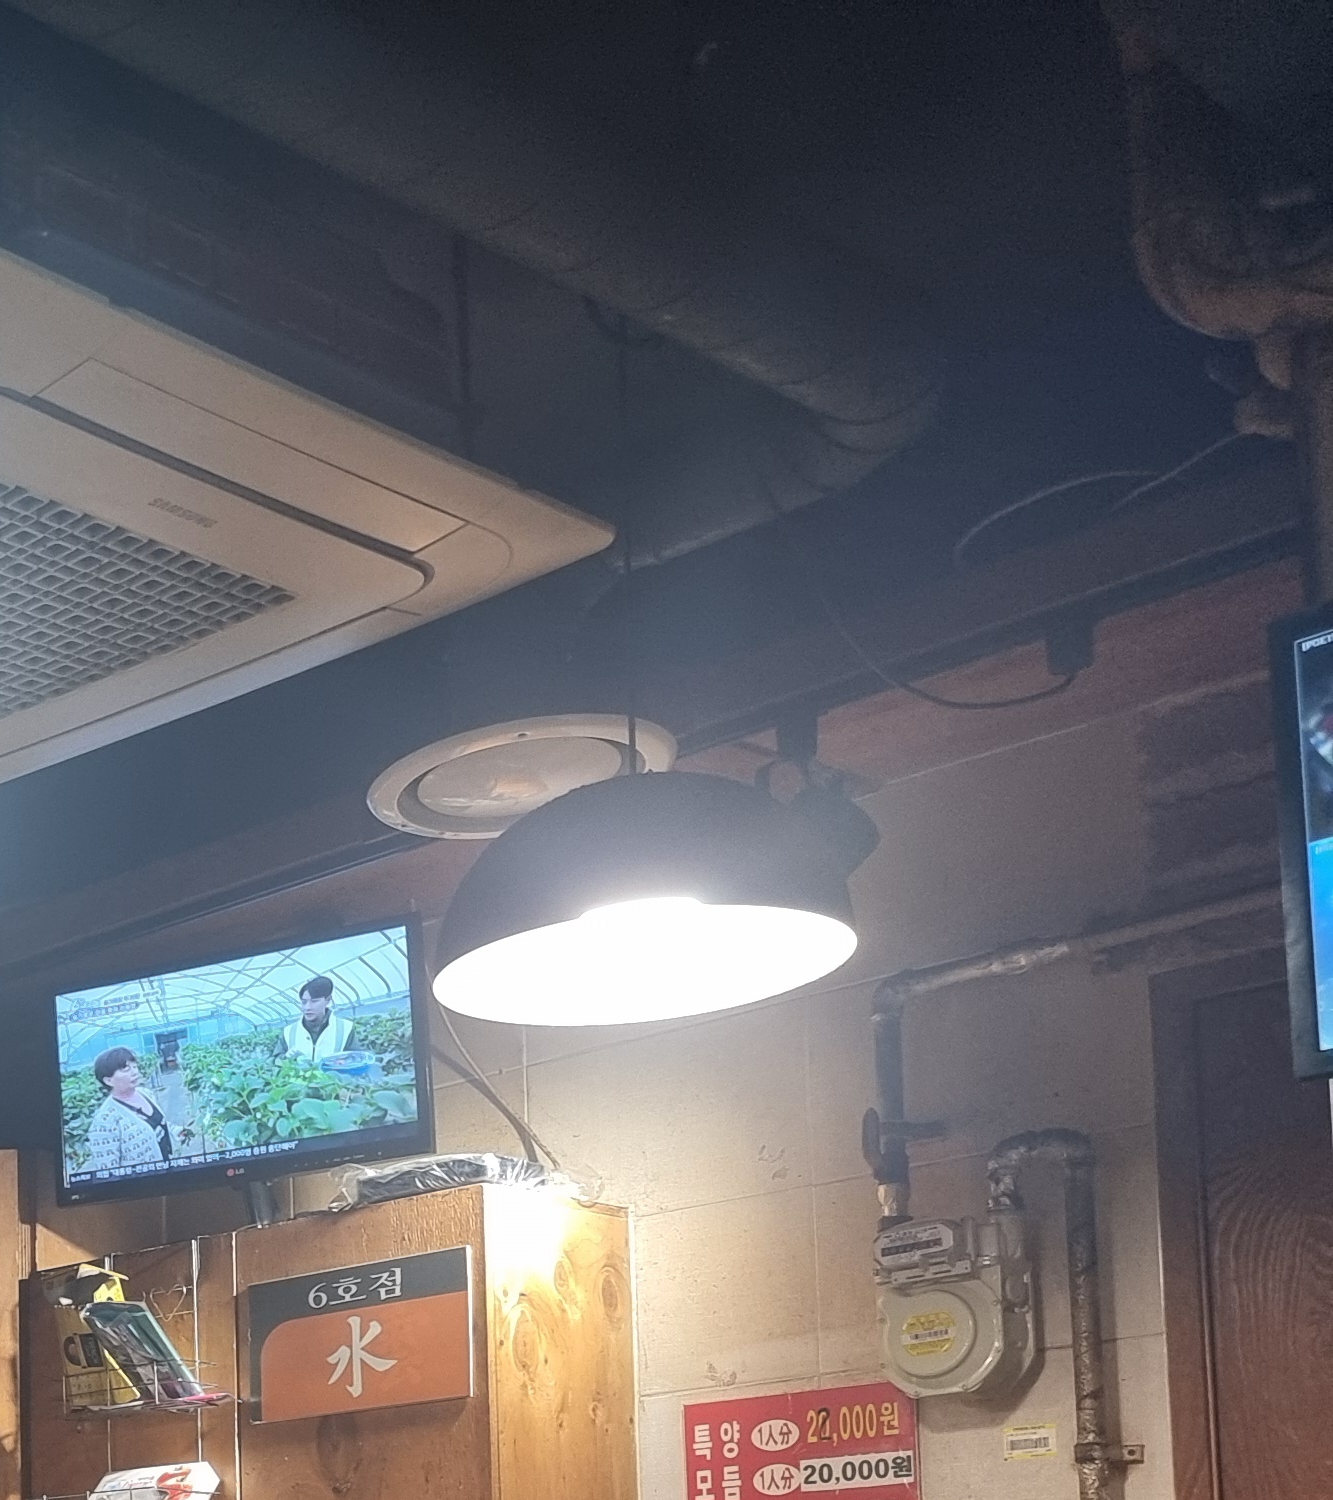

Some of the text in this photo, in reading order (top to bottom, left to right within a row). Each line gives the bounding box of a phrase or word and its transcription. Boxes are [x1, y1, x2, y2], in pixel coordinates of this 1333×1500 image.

[147, 497, 219, 529] SAMSUNG
[307, 1267, 403, 1310] 6호점
[325, 1315, 399, 1399] 水
[802, 1455, 913, 1486] 20,000원
